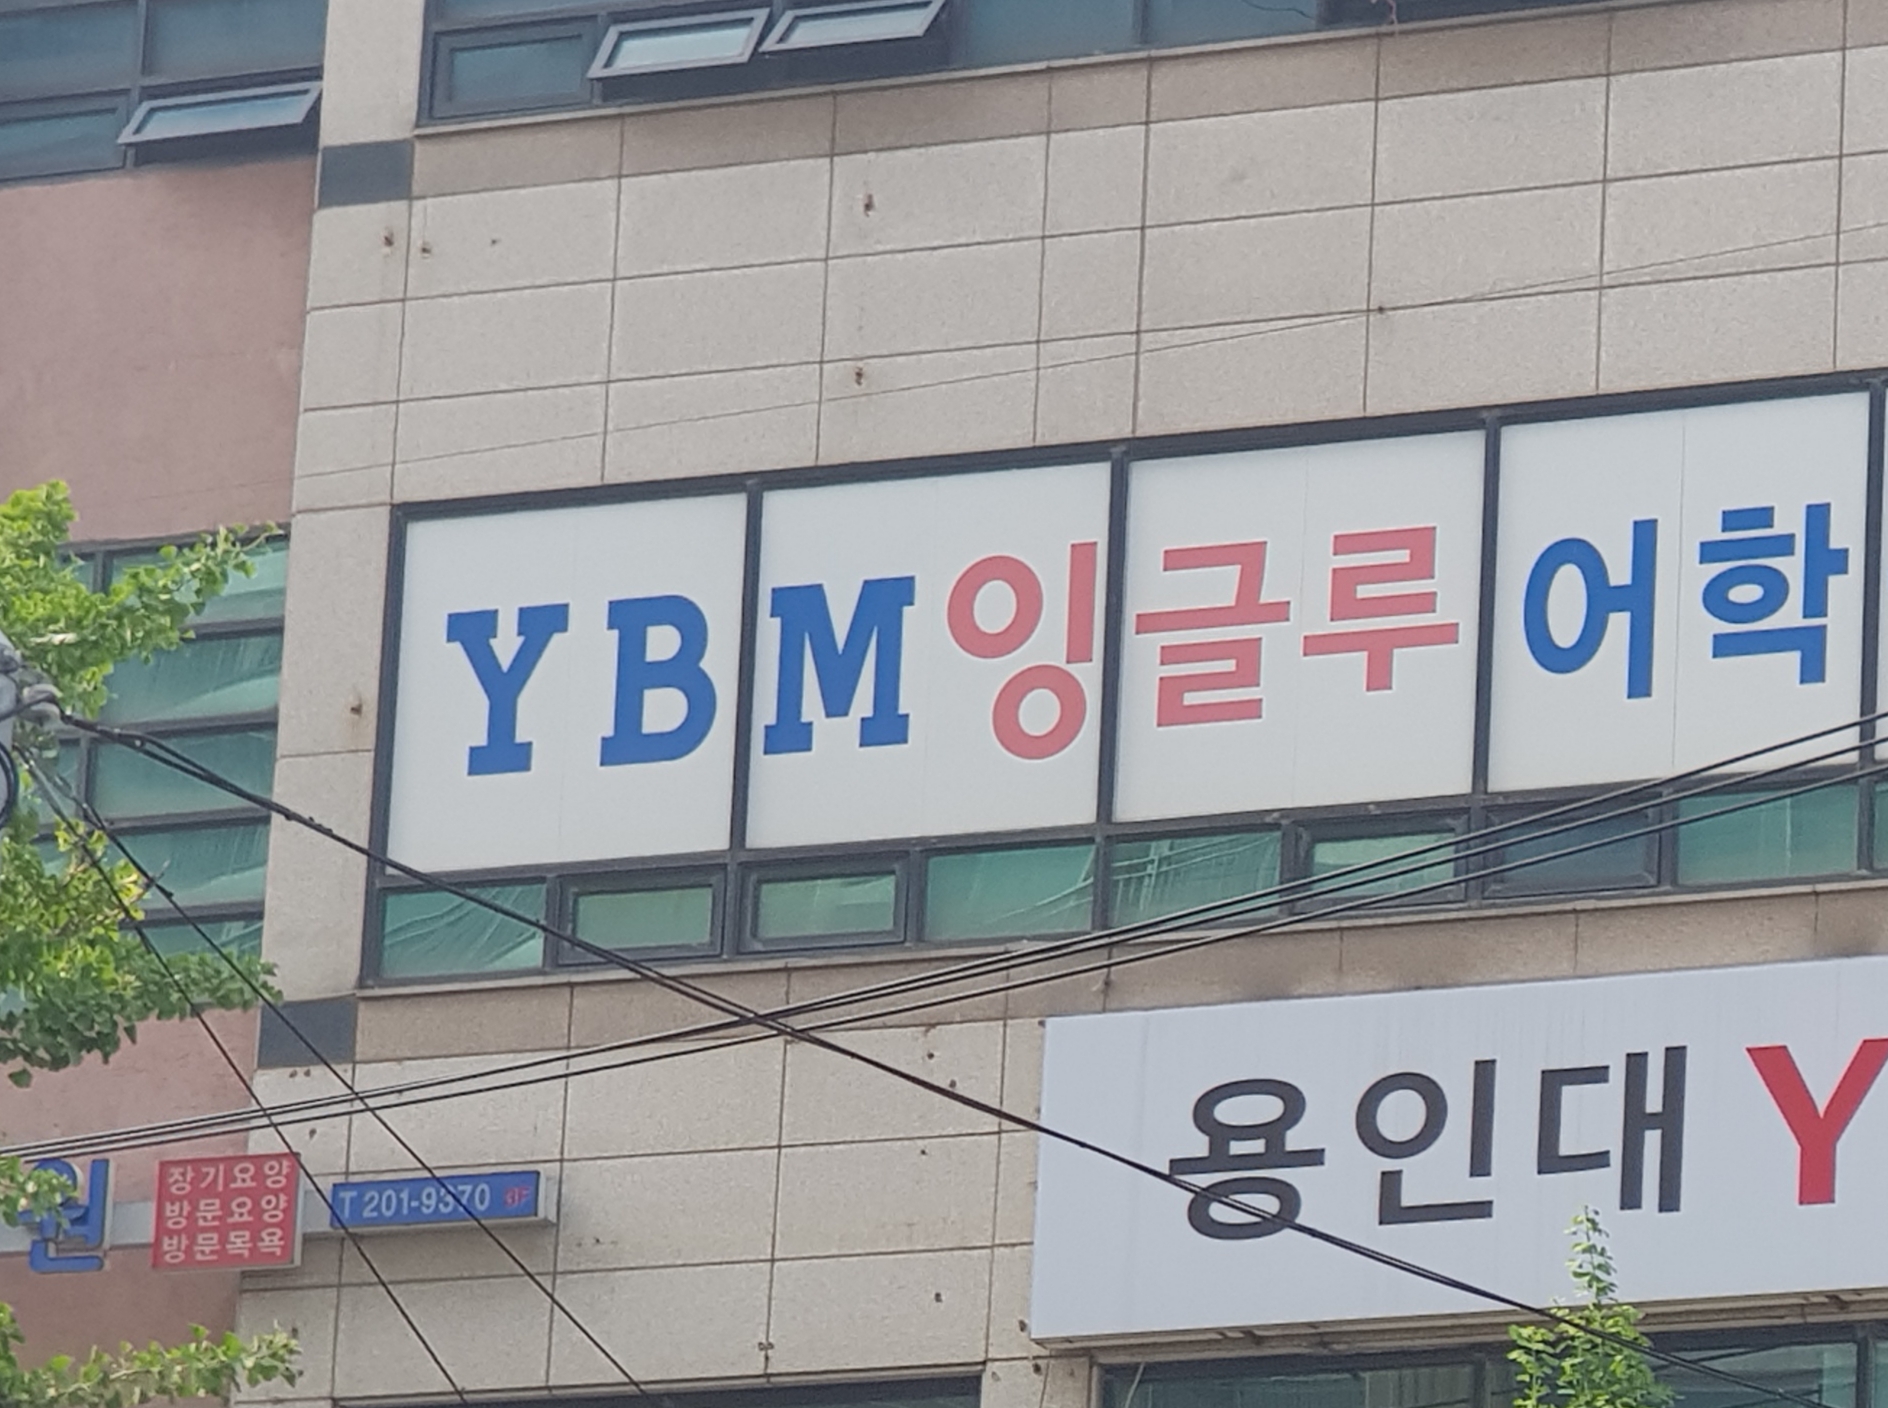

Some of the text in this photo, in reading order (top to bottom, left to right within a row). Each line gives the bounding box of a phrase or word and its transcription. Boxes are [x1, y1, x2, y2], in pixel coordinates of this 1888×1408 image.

[1168, 1046, 1688, 1241] 용인대
[167, 1158, 292, 1196] 장기요양
[164, 1191, 289, 1230] 방문요양
[161, 1226, 286, 1264] 방문목욕
